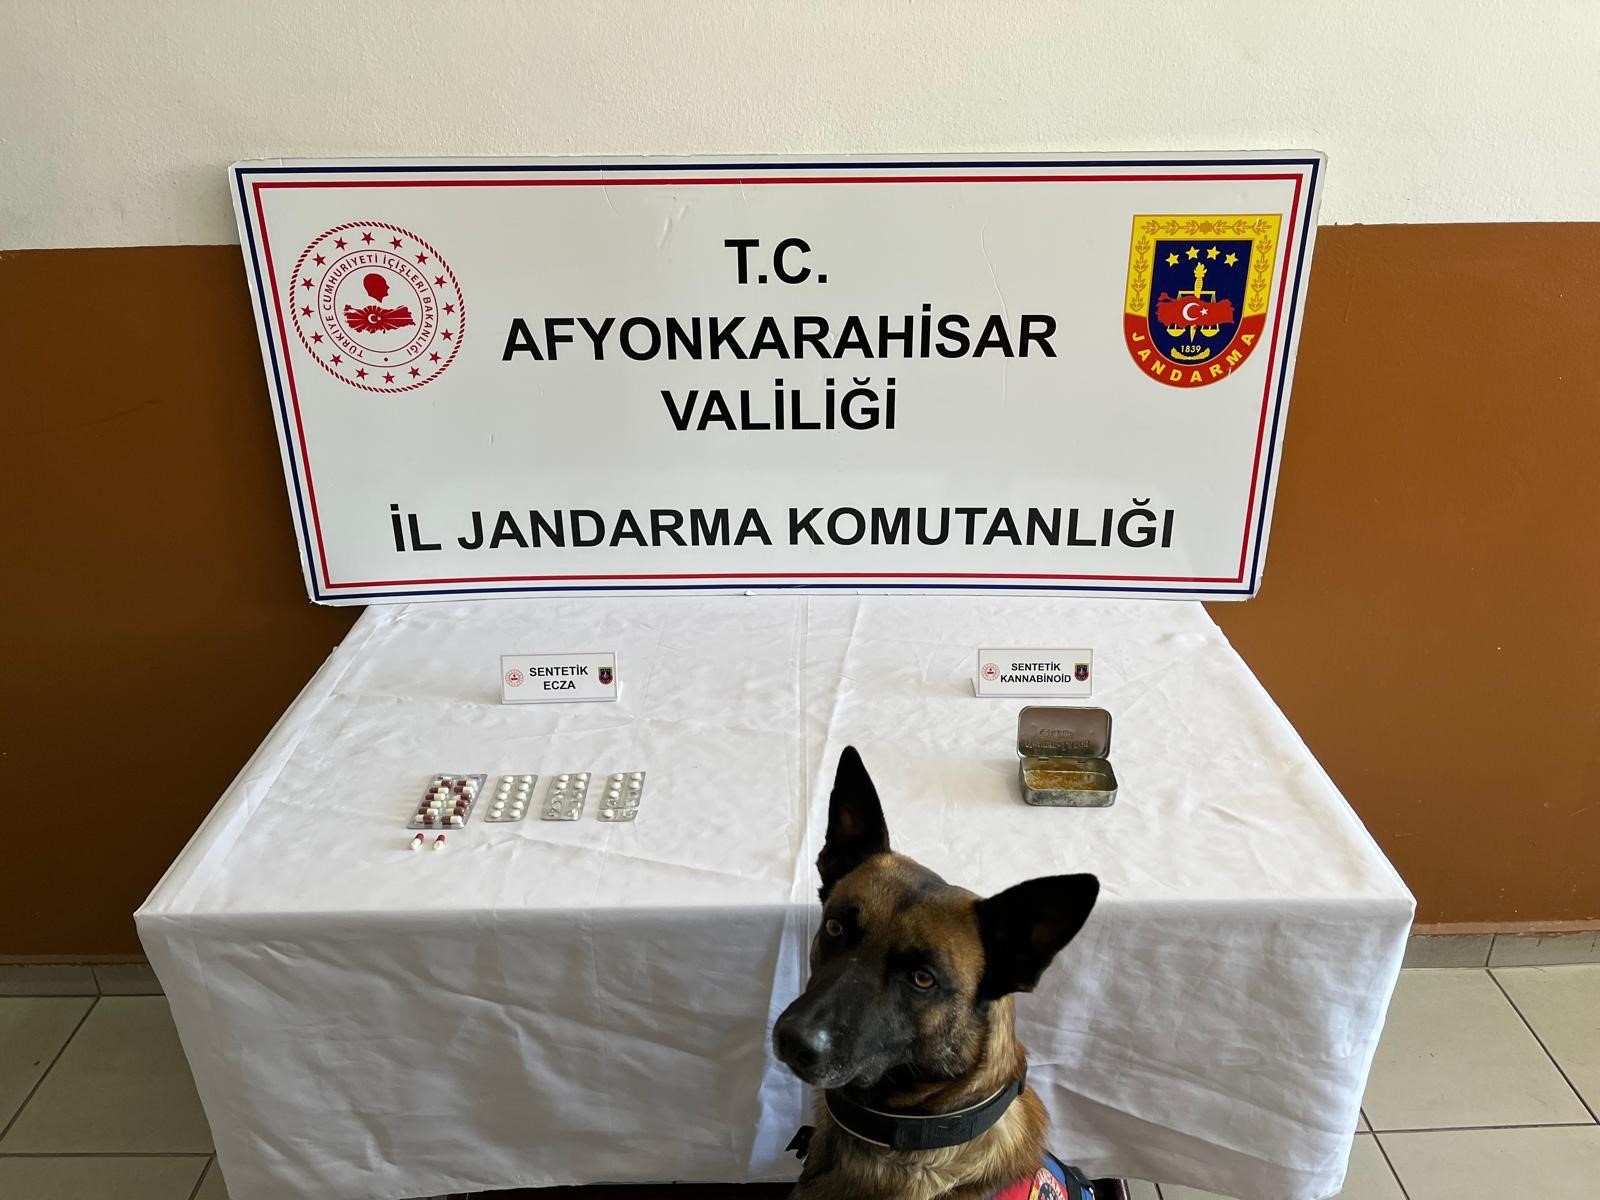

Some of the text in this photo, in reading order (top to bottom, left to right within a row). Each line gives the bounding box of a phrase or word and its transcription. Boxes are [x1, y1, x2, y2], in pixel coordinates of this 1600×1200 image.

[724, 237, 828, 285] T.C.
[322, 253, 434, 358] TÜRKİYE CUMHURİYETİ İÇİŞLERİ BAKANLIĞI
[501, 303, 1058, 362] AFYONKARAHİSAR
[1180, 345, 1202, 354] 1839
[1132, 332, 1255, 383] JANDARMA
[660, 376, 896, 431] VALİLİĞİ
[389, 497, 1175, 552] İL JANDARMA KOMUTANLIĞI
[529, 664, 588, 677] SENTETİK
[543, 680, 576, 691] ECZA
[1000, 673, 1072, 683] KANNABİNOİD
[1011, 661, 1061, 672] SENTETİK
